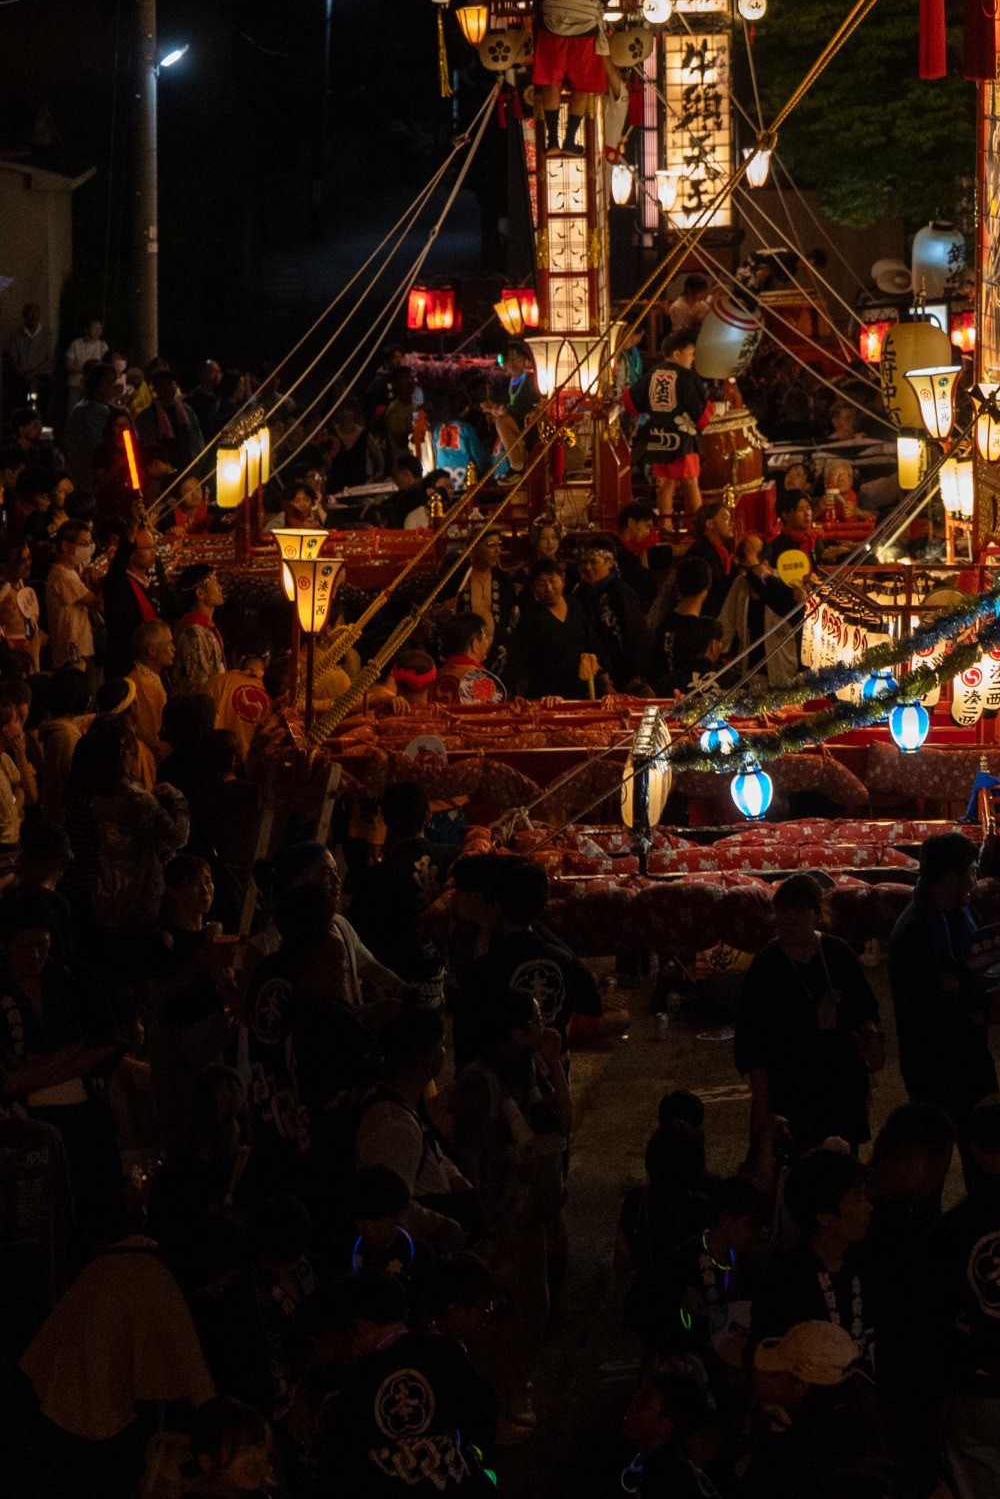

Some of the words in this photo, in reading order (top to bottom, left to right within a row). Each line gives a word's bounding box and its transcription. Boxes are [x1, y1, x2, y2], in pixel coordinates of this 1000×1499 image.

[674, 37, 723, 217] 牛頭天王
[317, 580, 330, 616] 湊二西
[959, 689, 982, 726] 湊二西
